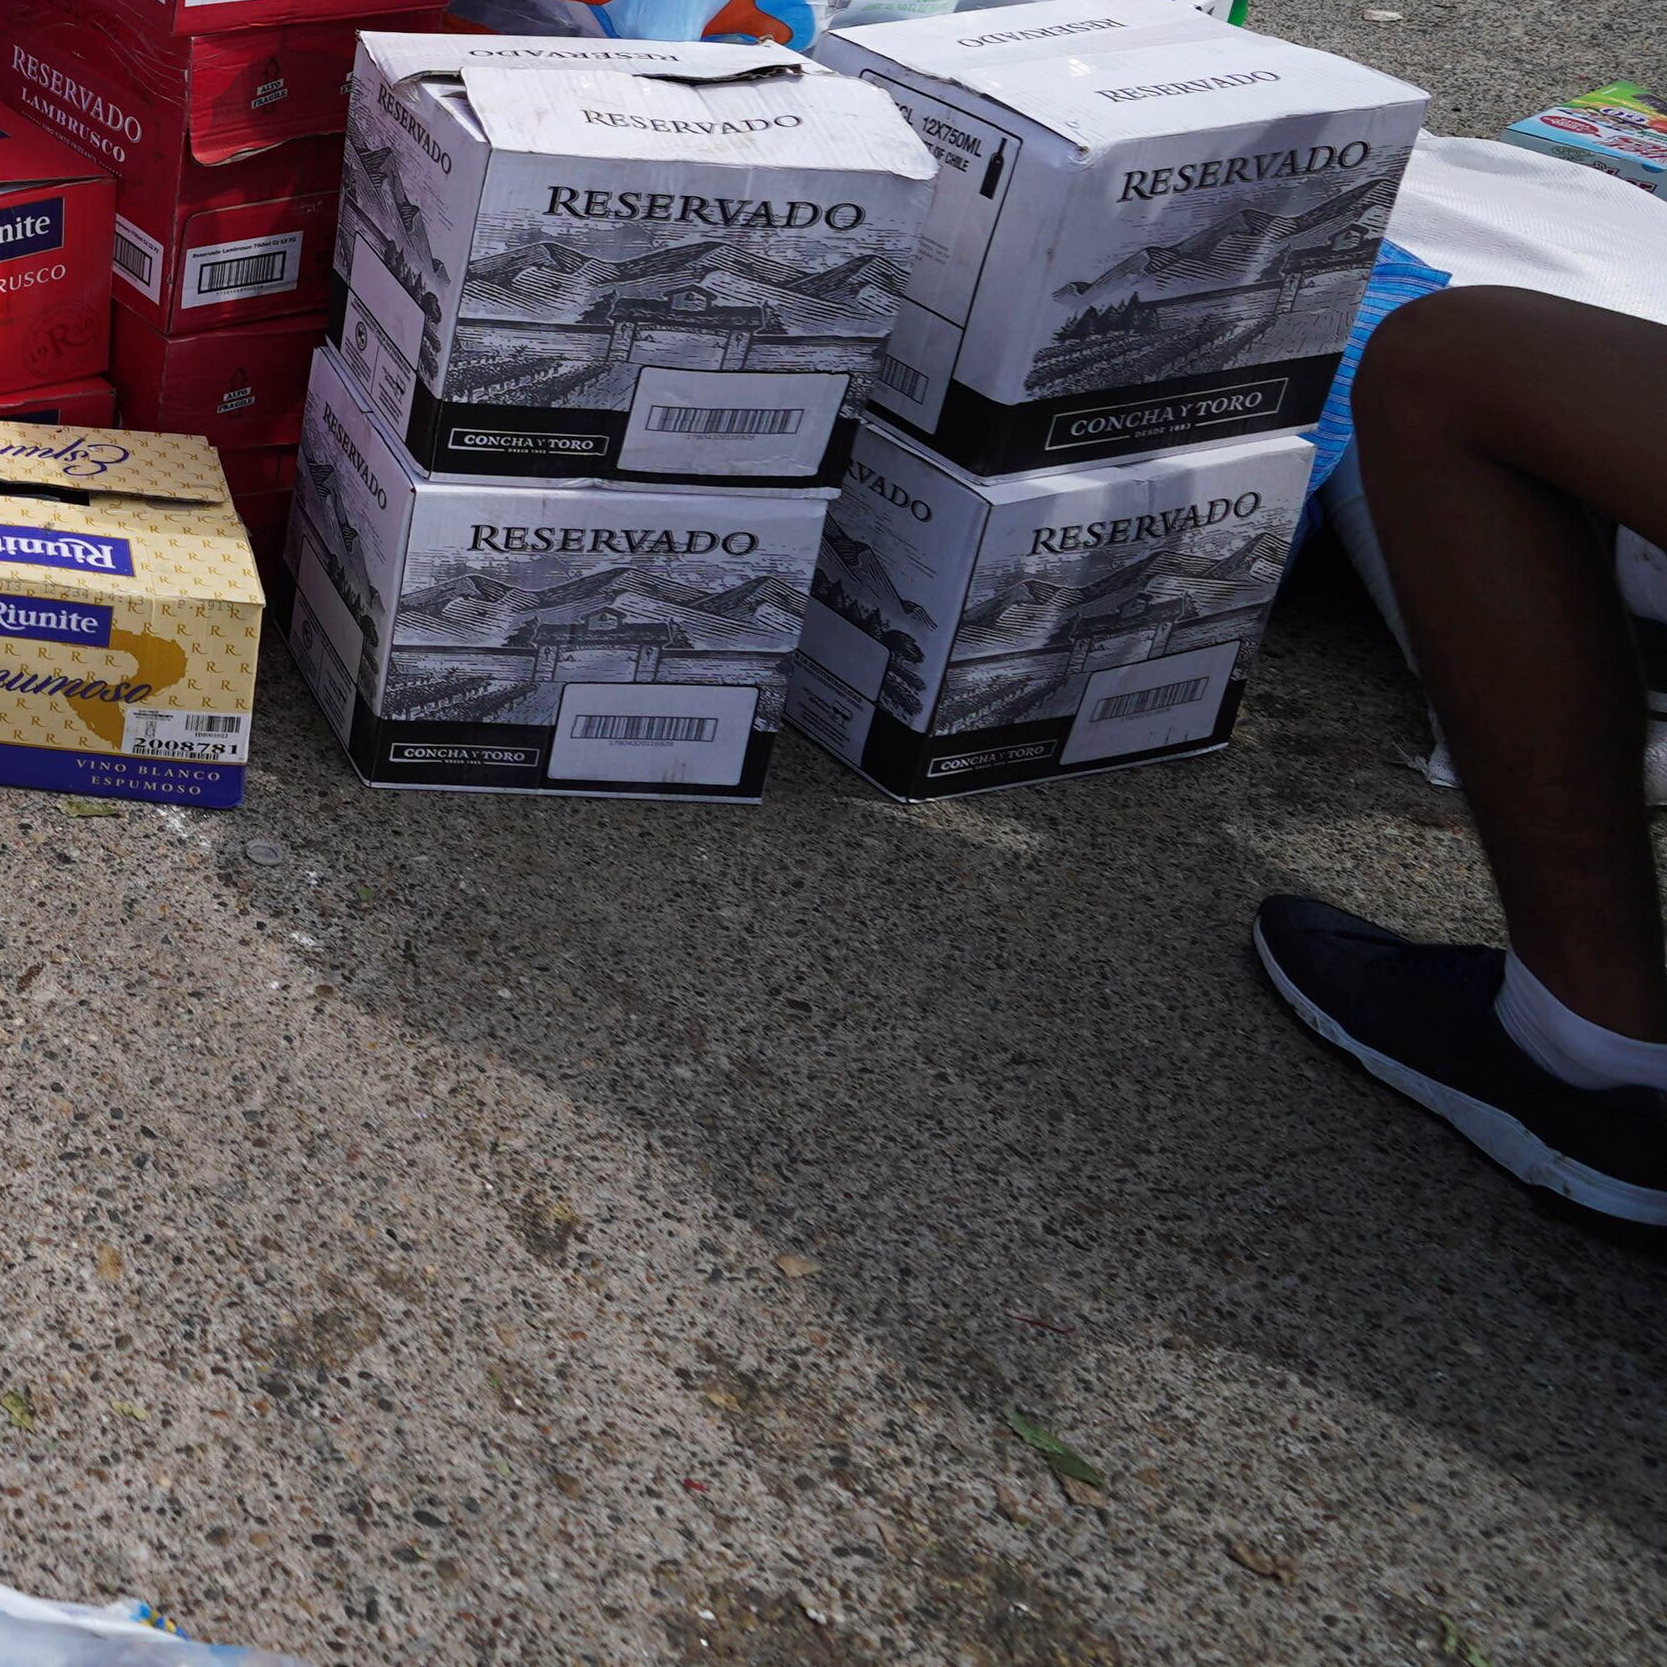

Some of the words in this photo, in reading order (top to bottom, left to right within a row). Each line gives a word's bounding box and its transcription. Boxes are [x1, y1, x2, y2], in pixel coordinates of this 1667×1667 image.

[957, 17, 1128, 49] RESERVADO
[467, 46, 682, 63] RESERVADO
[10, 44, 143, 145] RESERVADO
[250, 88, 289, 109] FRAGILE
[256, 81, 283, 96] ALTO
[1096, 68, 1282, 104] RESERVADO
[19, 87, 127, 165] LAMBRUSCO
[377, 81, 454, 177] RESERVADO
[580, 107, 805, 135] RESERVADO
[920, 115, 984, 160] 12X750ML
[1116, 139, 1372, 205] RESERVADO
[544, 184, 866, 232] RESERVADO
[216, 396, 256, 414] FRAGILE
[224, 390, 252, 405] ALTO
[1069, 404, 1173, 439] CONCHA
[1195, 390, 1264, 418] TORO
[321, 400, 390, 511] RESERVADO
[462, 433, 535, 448] CONCHA
[547, 436, 595, 452] TORO
[1028, 490, 1263, 556] RESERVADO
[469, 522, 761, 559] RESERVADO
[133, 737, 238, 757] 2008781
[403, 745, 471, 763] CONCHA
[482, 748, 527, 764] TORO
[939, 753, 997, 775] CONCHA
[1008, 743, 1046, 763] TORO
[75, 758, 128, 773] VINO
[139, 765, 221, 782] BLANCO
[91, 776, 202, 796] ESPUMOSO
